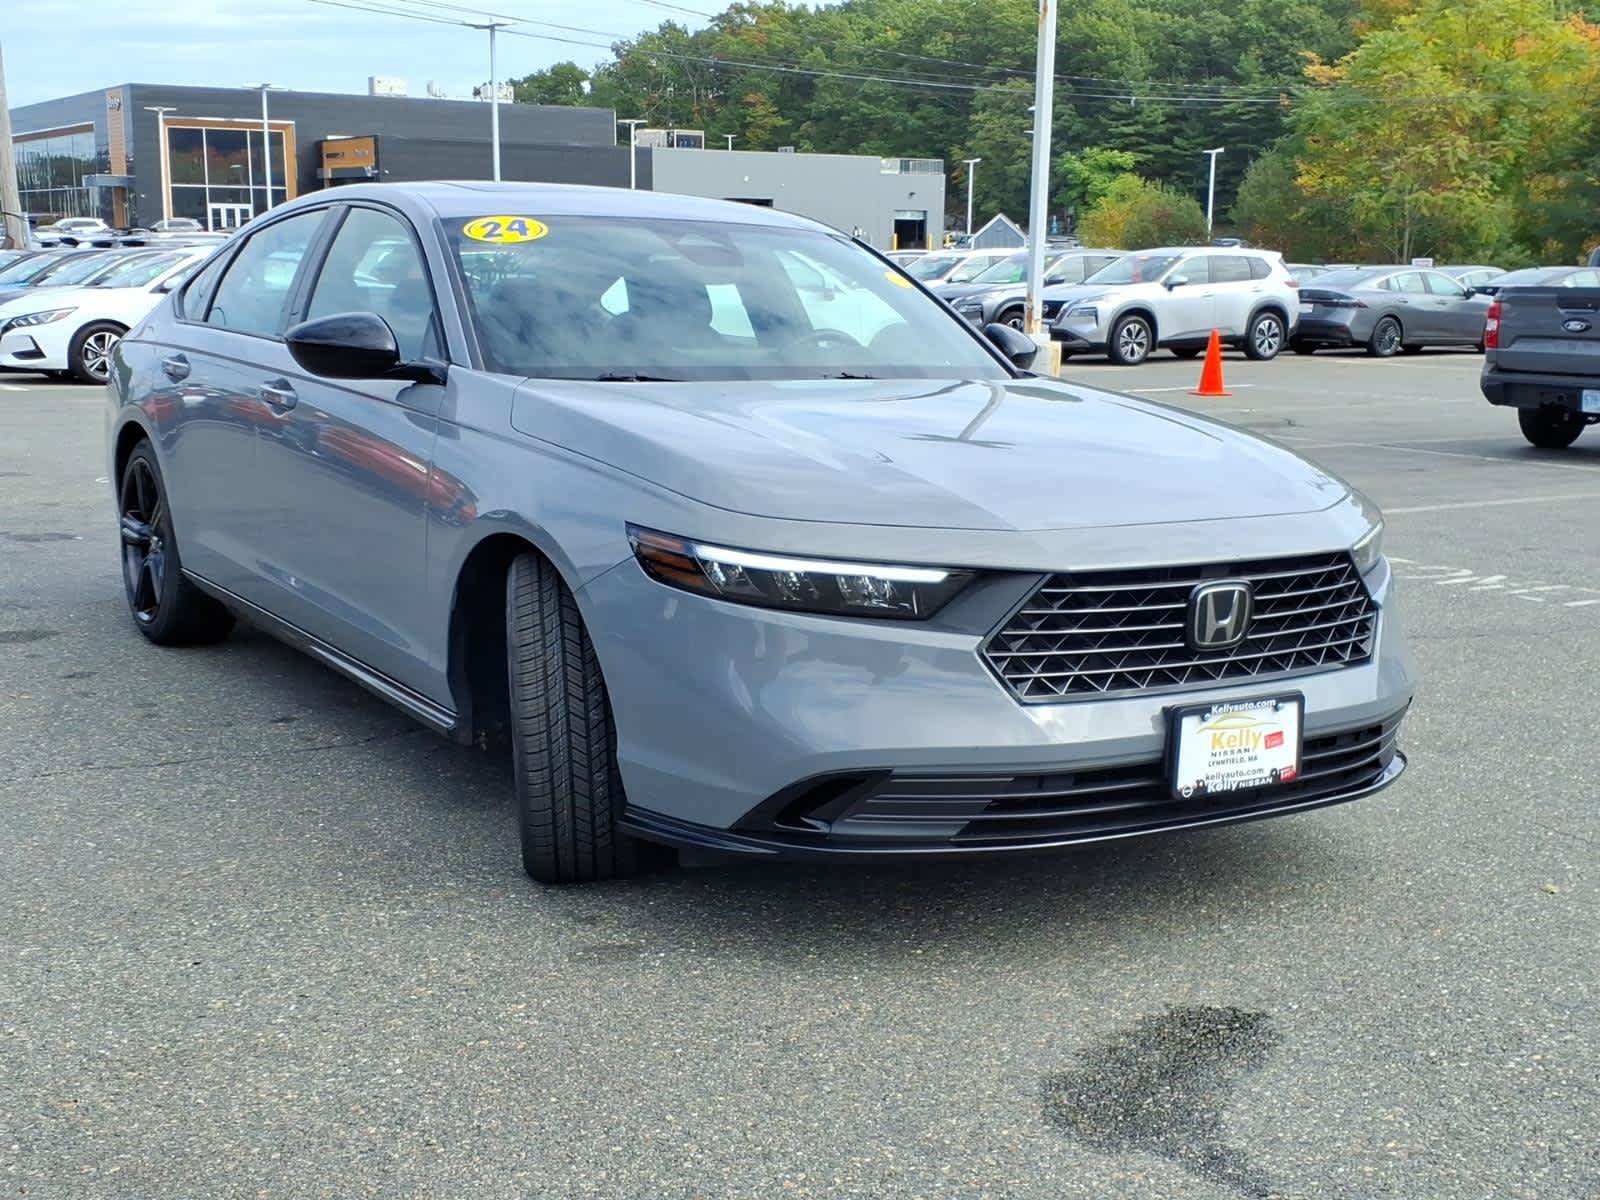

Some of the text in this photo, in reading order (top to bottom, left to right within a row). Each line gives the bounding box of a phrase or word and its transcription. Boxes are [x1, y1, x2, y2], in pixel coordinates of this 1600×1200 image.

[480, 219, 529, 239] 24
[1211, 699, 1276, 713] Kellyauto.com
[1211, 728, 1262, 751] Kelly
[1211, 747, 1250, 757] NISSAN
[1205, 768, 1264, 780] kellyauto.com
[1207, 777, 1272, 793] Kelly NISSAN
